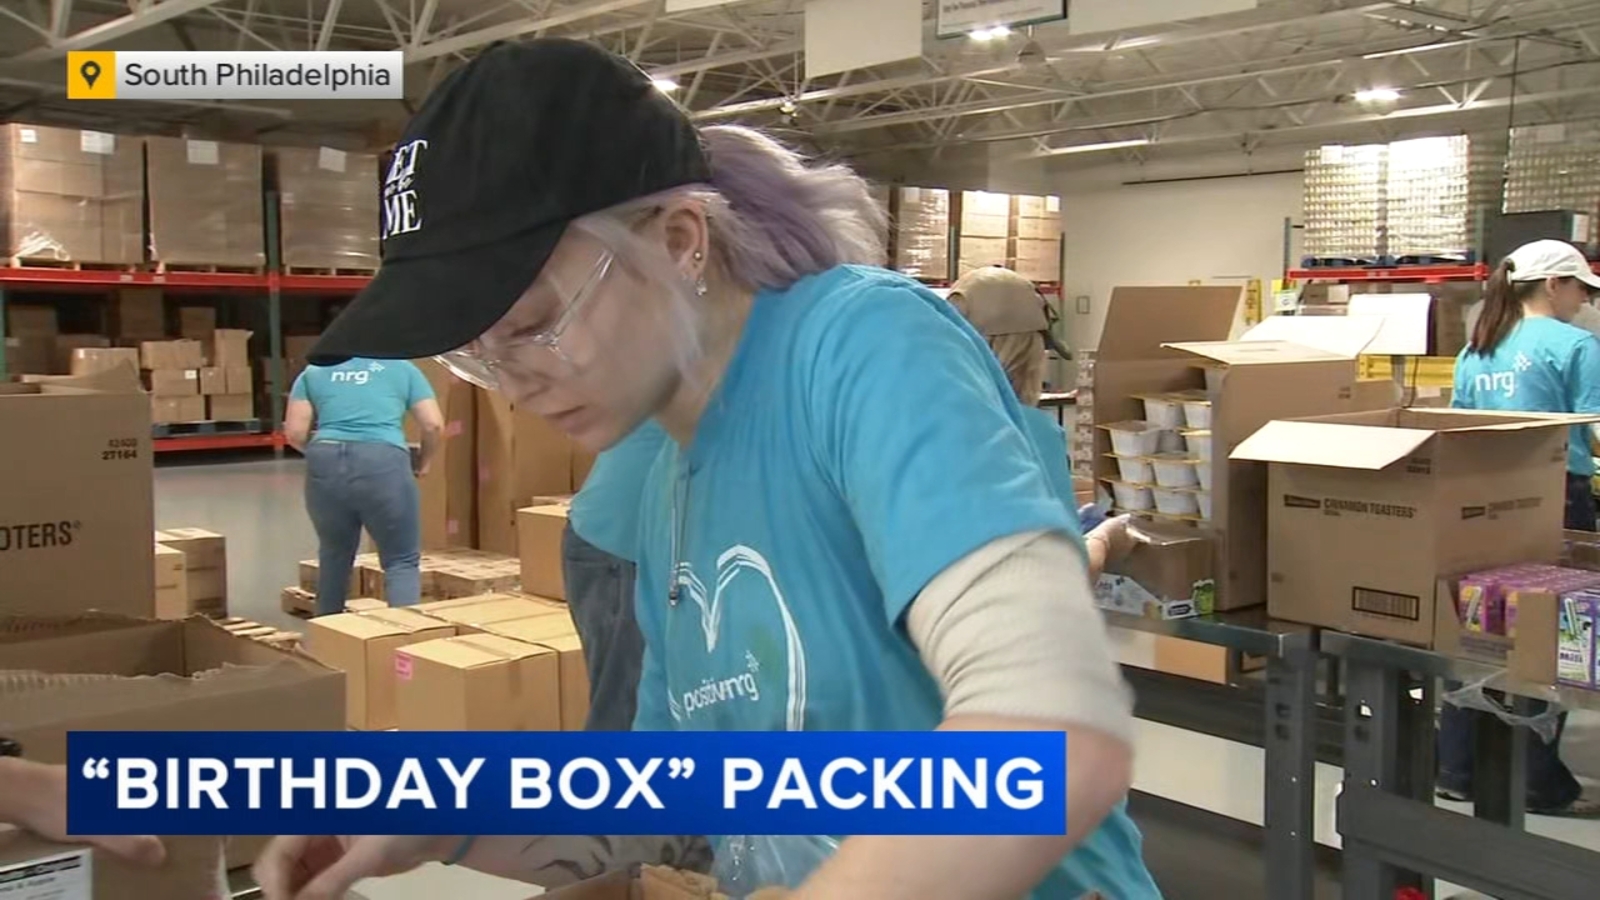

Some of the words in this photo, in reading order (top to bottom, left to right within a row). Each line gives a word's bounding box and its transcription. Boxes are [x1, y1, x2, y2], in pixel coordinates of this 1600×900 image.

[385, 139, 428, 187] ET
[330, 370, 369, 385] nrg
[1475, 370, 1515, 398] nrg
